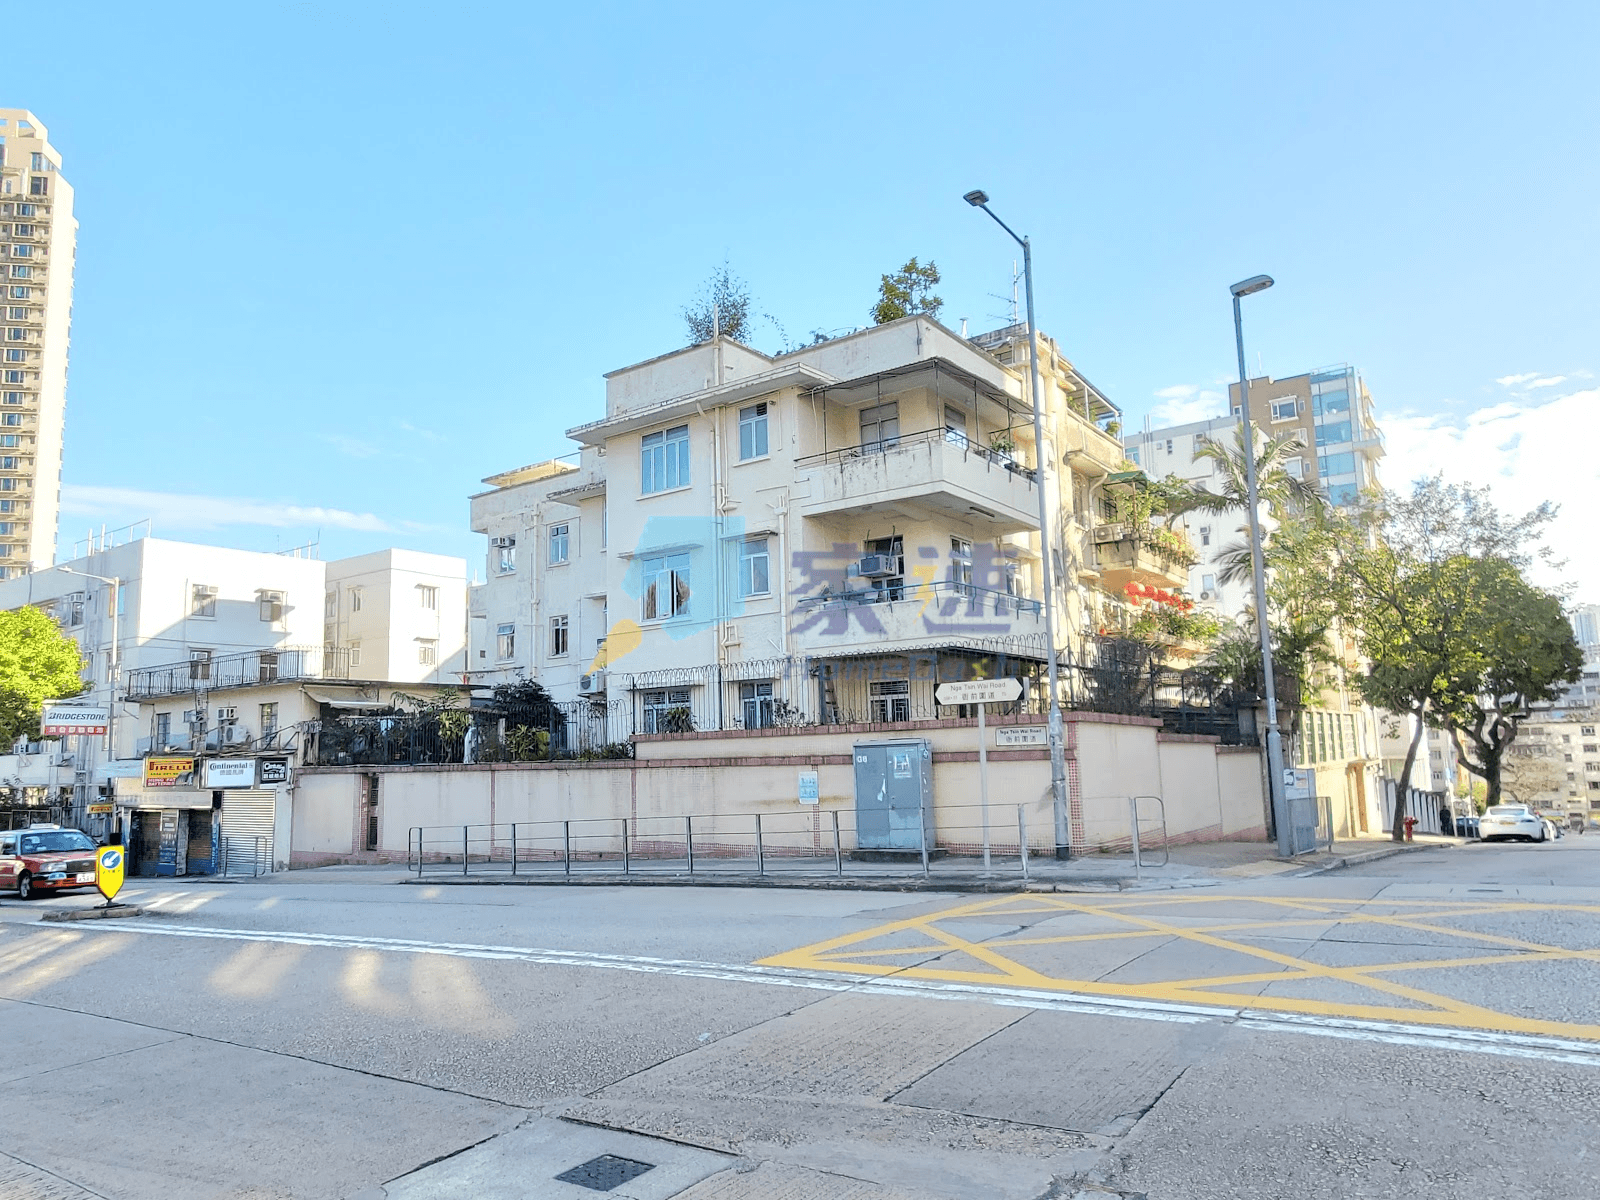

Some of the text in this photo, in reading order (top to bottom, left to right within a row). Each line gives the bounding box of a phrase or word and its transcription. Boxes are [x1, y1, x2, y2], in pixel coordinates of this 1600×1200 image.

[48, 712, 107, 720] BRIDGESTONE
[149, 761, 193, 771] PIRELLI
[209, 762, 248, 771] Continental
